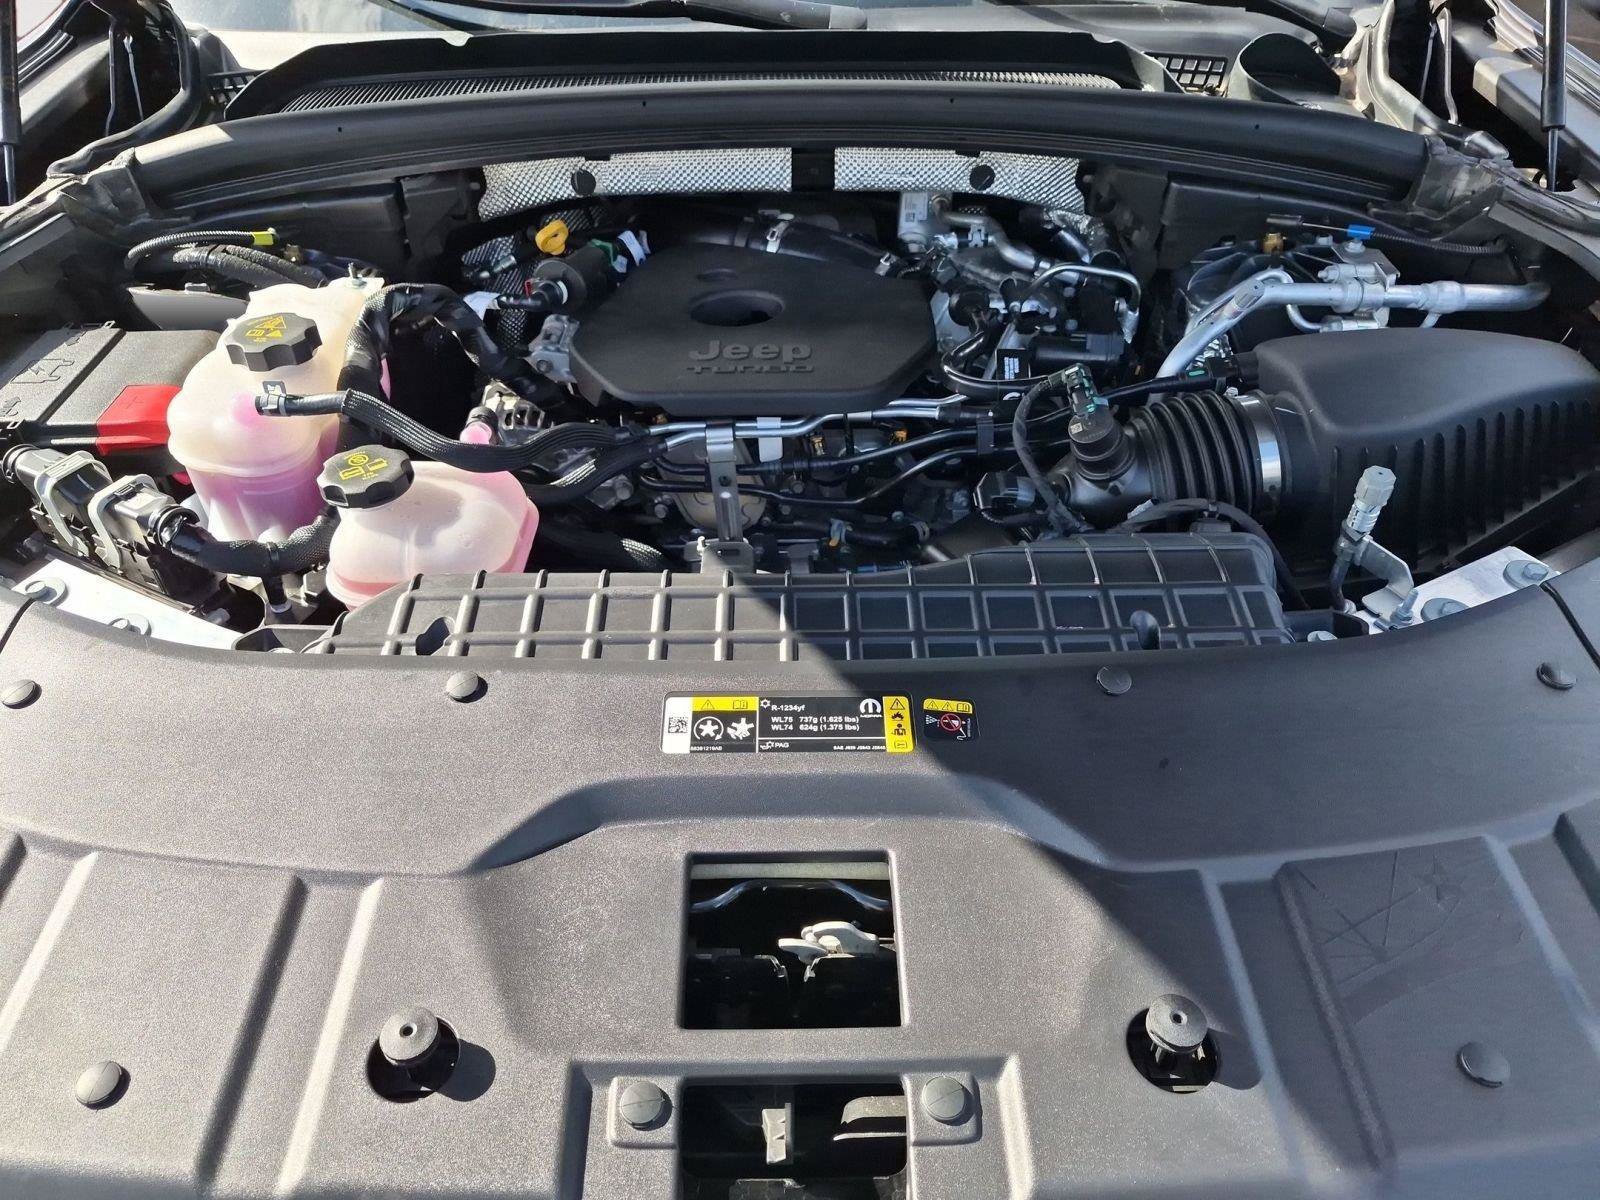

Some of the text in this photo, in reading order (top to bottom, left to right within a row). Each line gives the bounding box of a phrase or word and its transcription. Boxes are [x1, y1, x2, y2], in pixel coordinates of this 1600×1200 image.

[689, 339, 812, 364] Jeep
[687, 365, 815, 375] TURBO
[771, 704, 805, 712] R-1234yf
[799, 716, 818, 724] 737g
[819, 716, 843, 724] (1.625
[844, 716, 860, 724] lbs)
[799, 724, 818, 732] 624g
[819, 724, 843, 732] (1.375
[844, 724, 860, 732] lbs)
